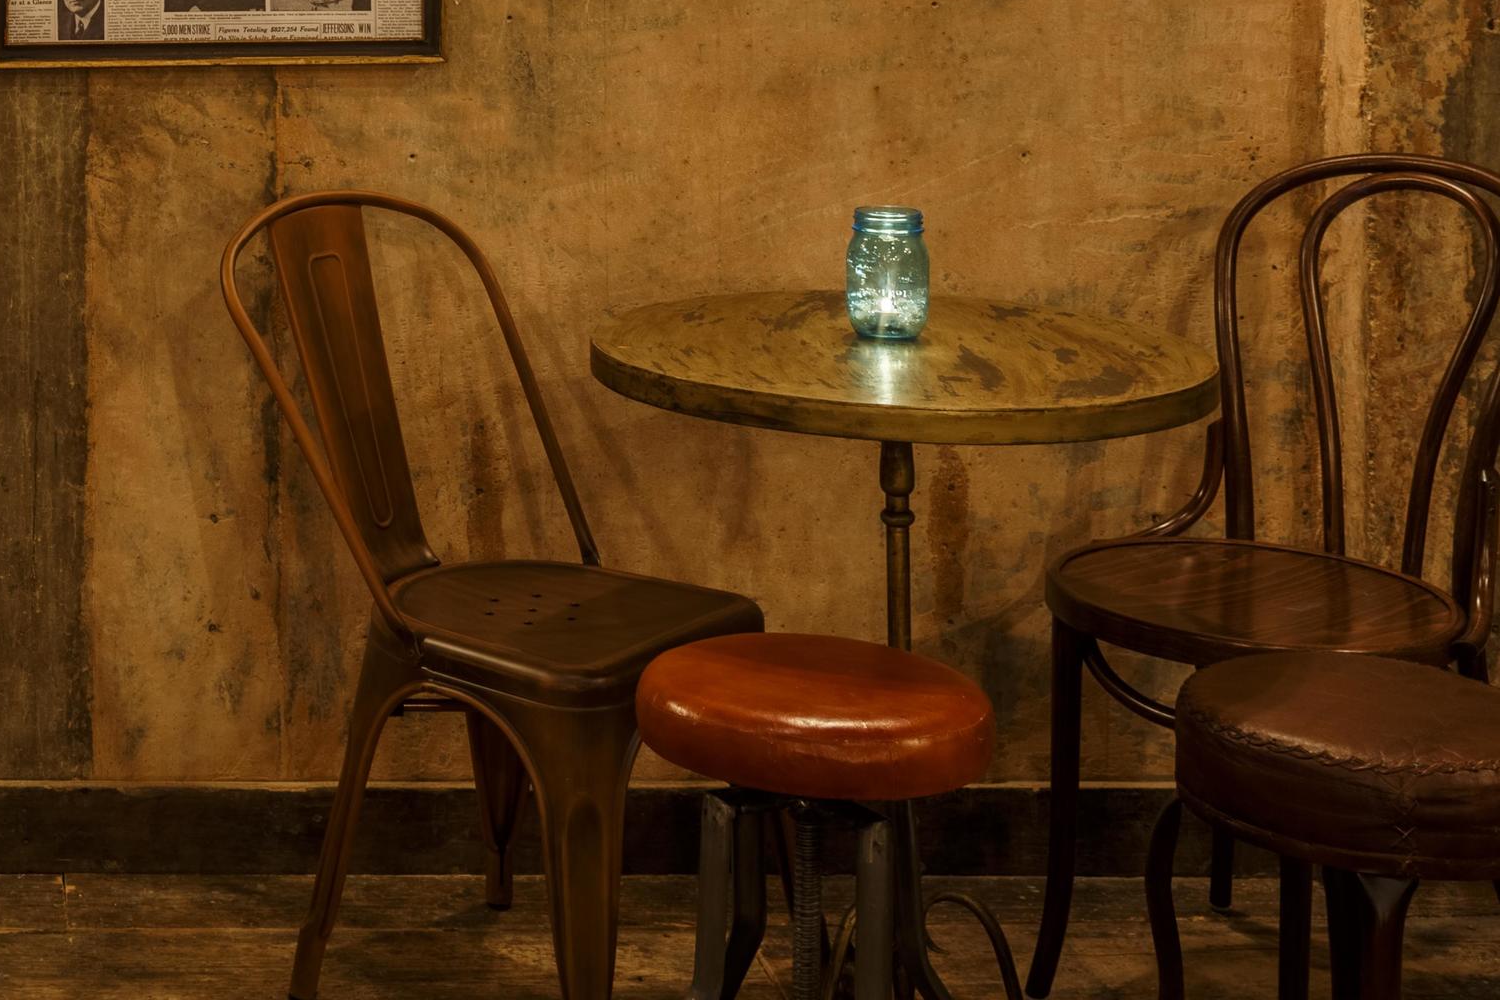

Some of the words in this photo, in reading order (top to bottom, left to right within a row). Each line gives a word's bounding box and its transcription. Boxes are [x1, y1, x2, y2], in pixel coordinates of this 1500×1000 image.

[179, 24, 191, 34] MEN
[192, 24, 211, 34] STRIKE
[322, 23, 355, 33] JEFFERSONS
[358, 23, 371, 33] WIN
